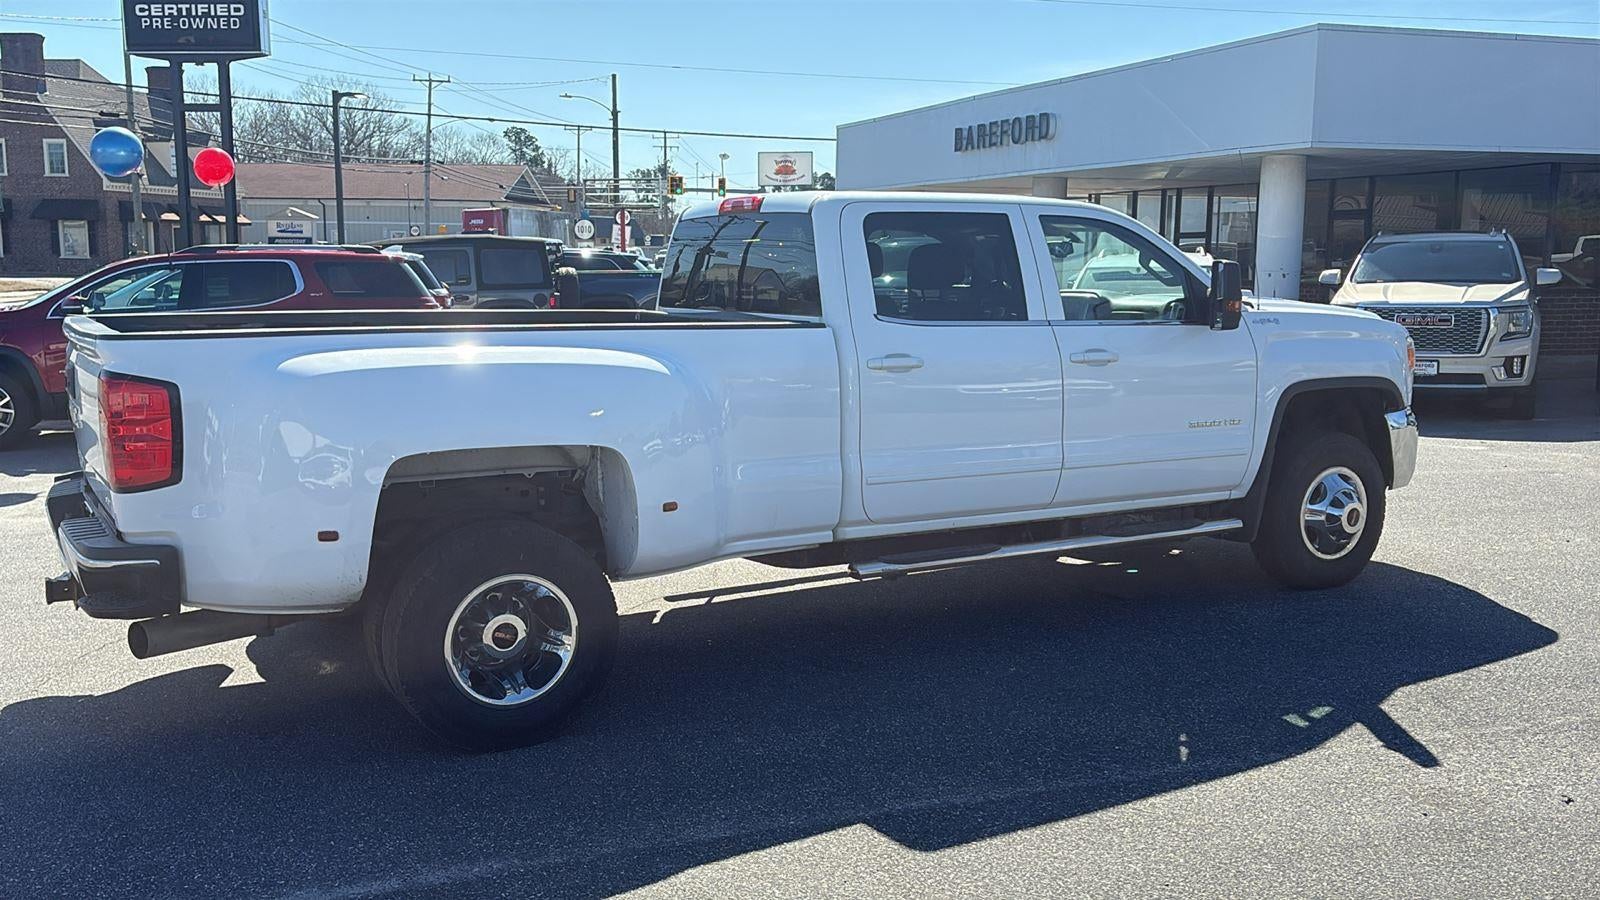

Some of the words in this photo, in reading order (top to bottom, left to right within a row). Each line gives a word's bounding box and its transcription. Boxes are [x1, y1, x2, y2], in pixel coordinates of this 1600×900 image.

[135, 3, 245, 16] CERTIFIED
[141, 17, 241, 29] PRE-OWNED
[954, 112, 1053, 152] BAREFORD
[577, 225, 592, 234] 1010
[1397, 314, 1452, 326] GMC
